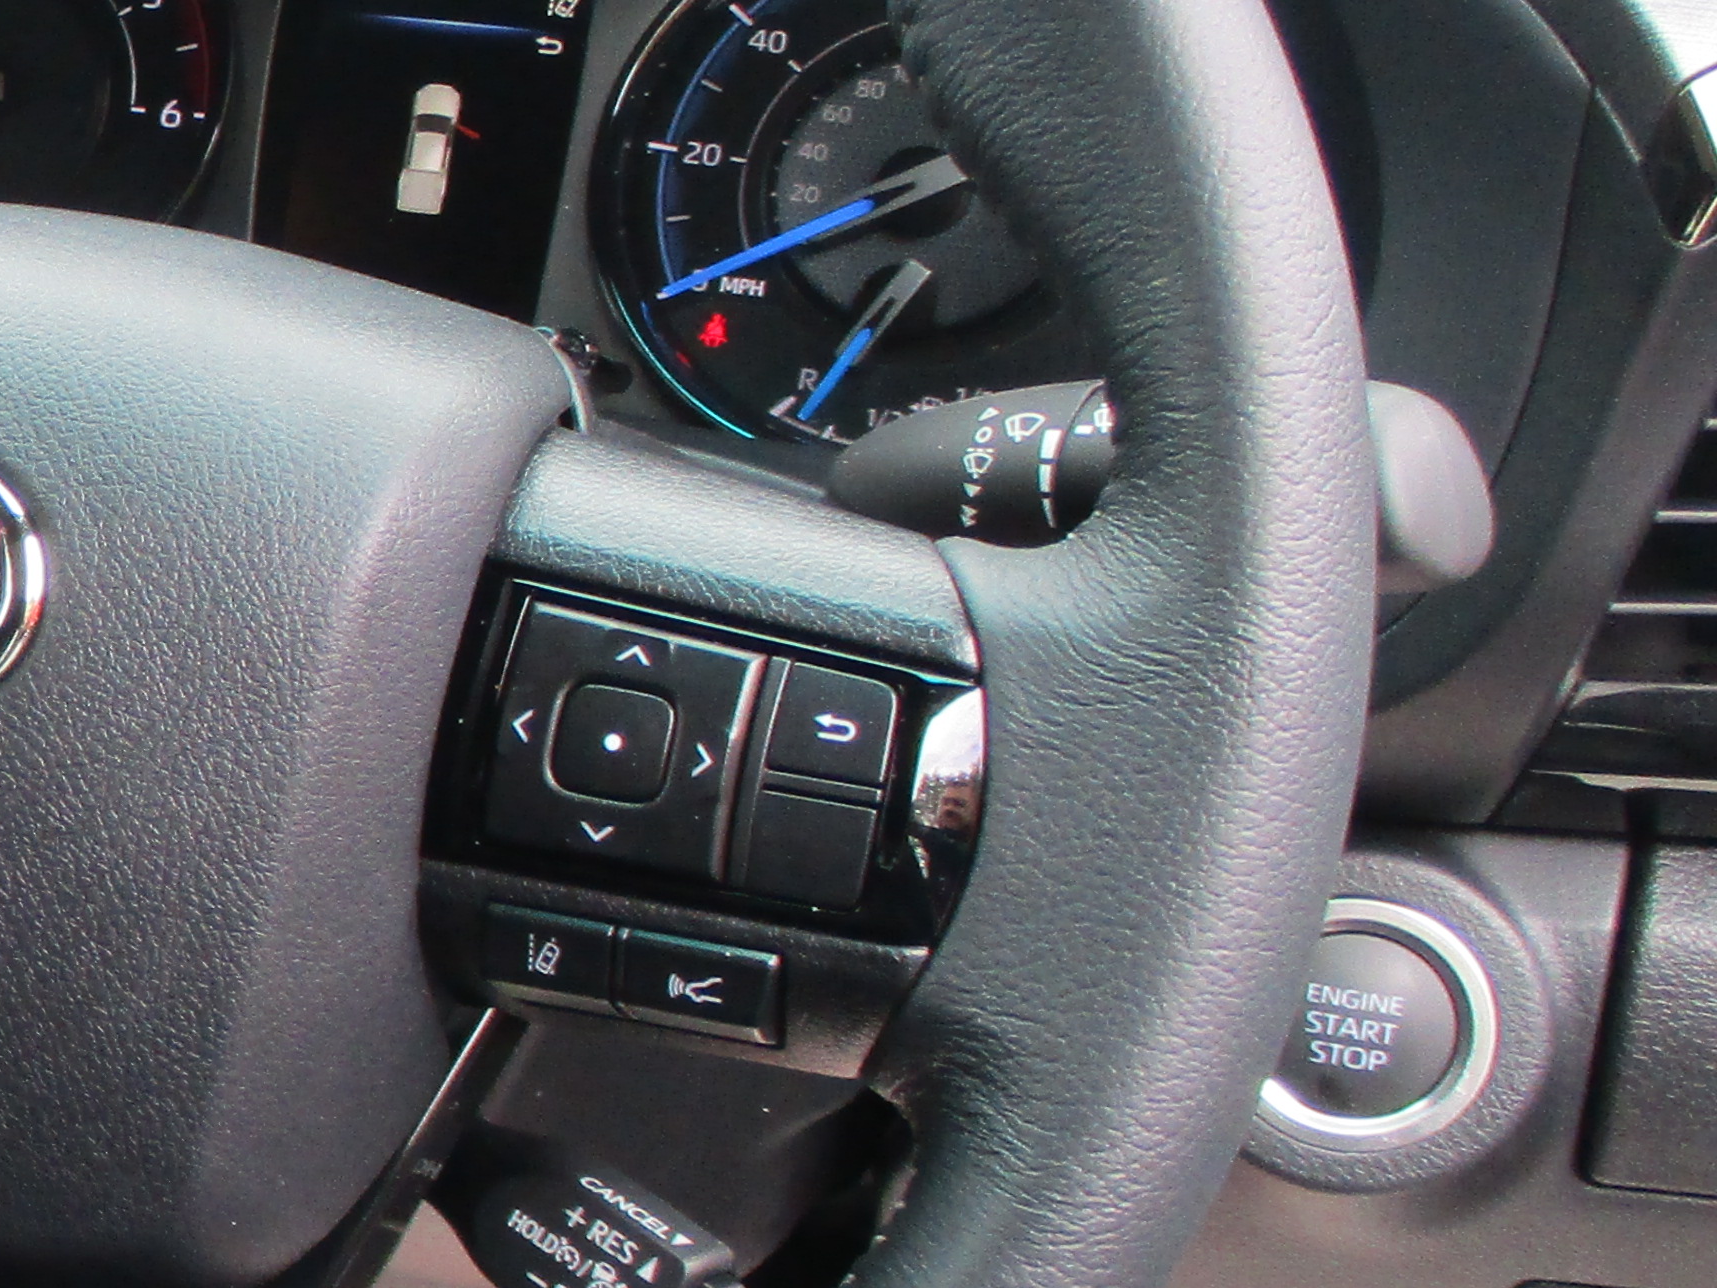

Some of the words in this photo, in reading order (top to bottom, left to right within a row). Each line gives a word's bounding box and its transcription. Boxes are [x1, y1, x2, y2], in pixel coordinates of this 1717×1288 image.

[747, 28, 788, 55] 40
[854, 79, 887, 100] 80
[159, 98, 182, 129] 6
[681, 140, 723, 167] 20
[797, 142, 829, 162] 40
[790, 183, 822, 204] 20
[719, 276, 766, 298] MPH
[1305, 981, 1408, 1018] ENGINE
[1303, 1009, 1401, 1046] START
[1307, 1039, 1389, 1072] STOP
[578, 1175, 672, 1241] CANCEL
[507, 1208, 560, 1255] HOLD
